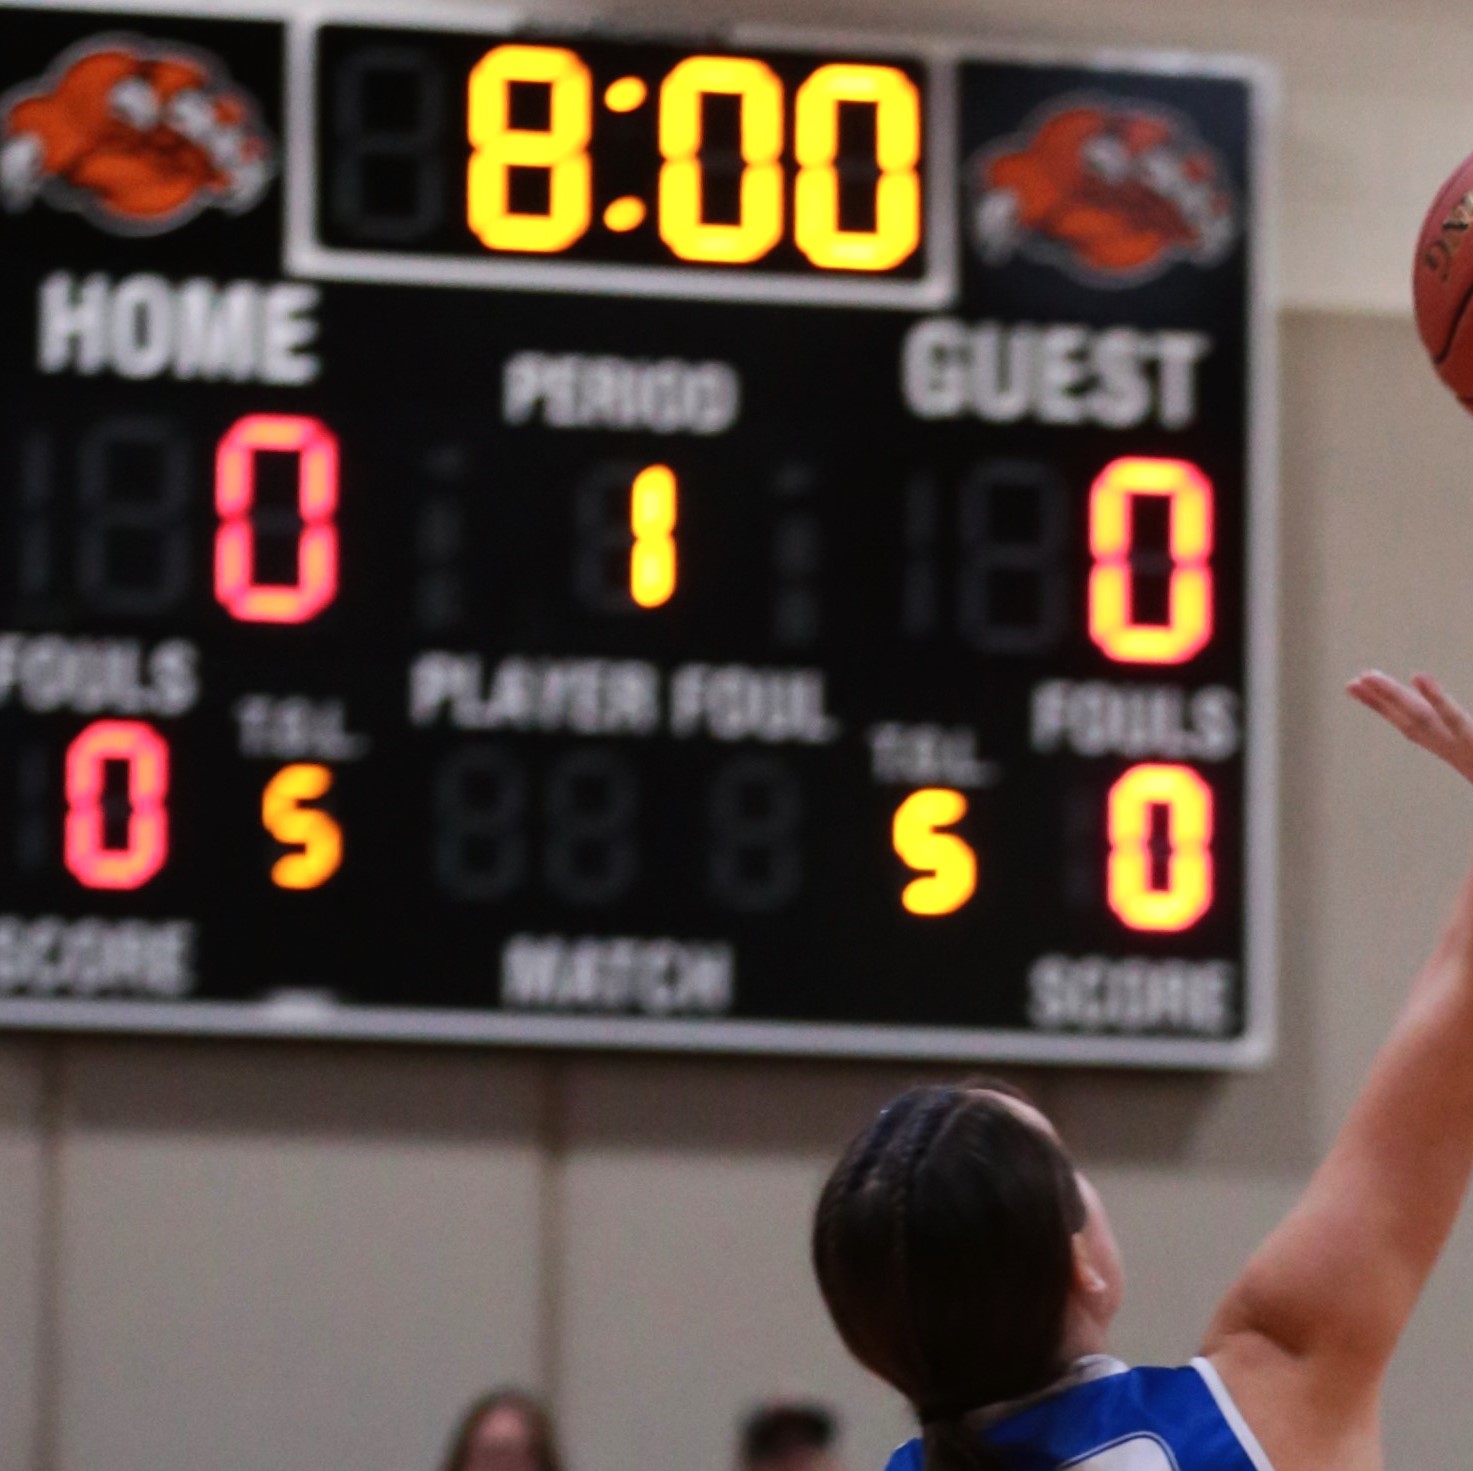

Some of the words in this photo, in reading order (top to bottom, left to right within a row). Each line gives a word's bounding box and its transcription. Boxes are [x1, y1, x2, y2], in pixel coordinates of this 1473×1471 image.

[466, 44, 922, 272] 8:00
[38, 270, 321, 385] HOME
[502, 349, 740, 436] PERIOD
[901, 317, 1210, 431] GUEST
[214, 413, 339, 624] 0
[630, 464, 677, 608] 1
[1088, 455, 1214, 665] 0
[409, 649, 659, 735] PLAYER
[670, 660, 839, 745] FOUL
[1028, 677, 1240, 763] FOULS
[63, 718, 170, 891] 0
[1106, 761, 1215, 933] 0
